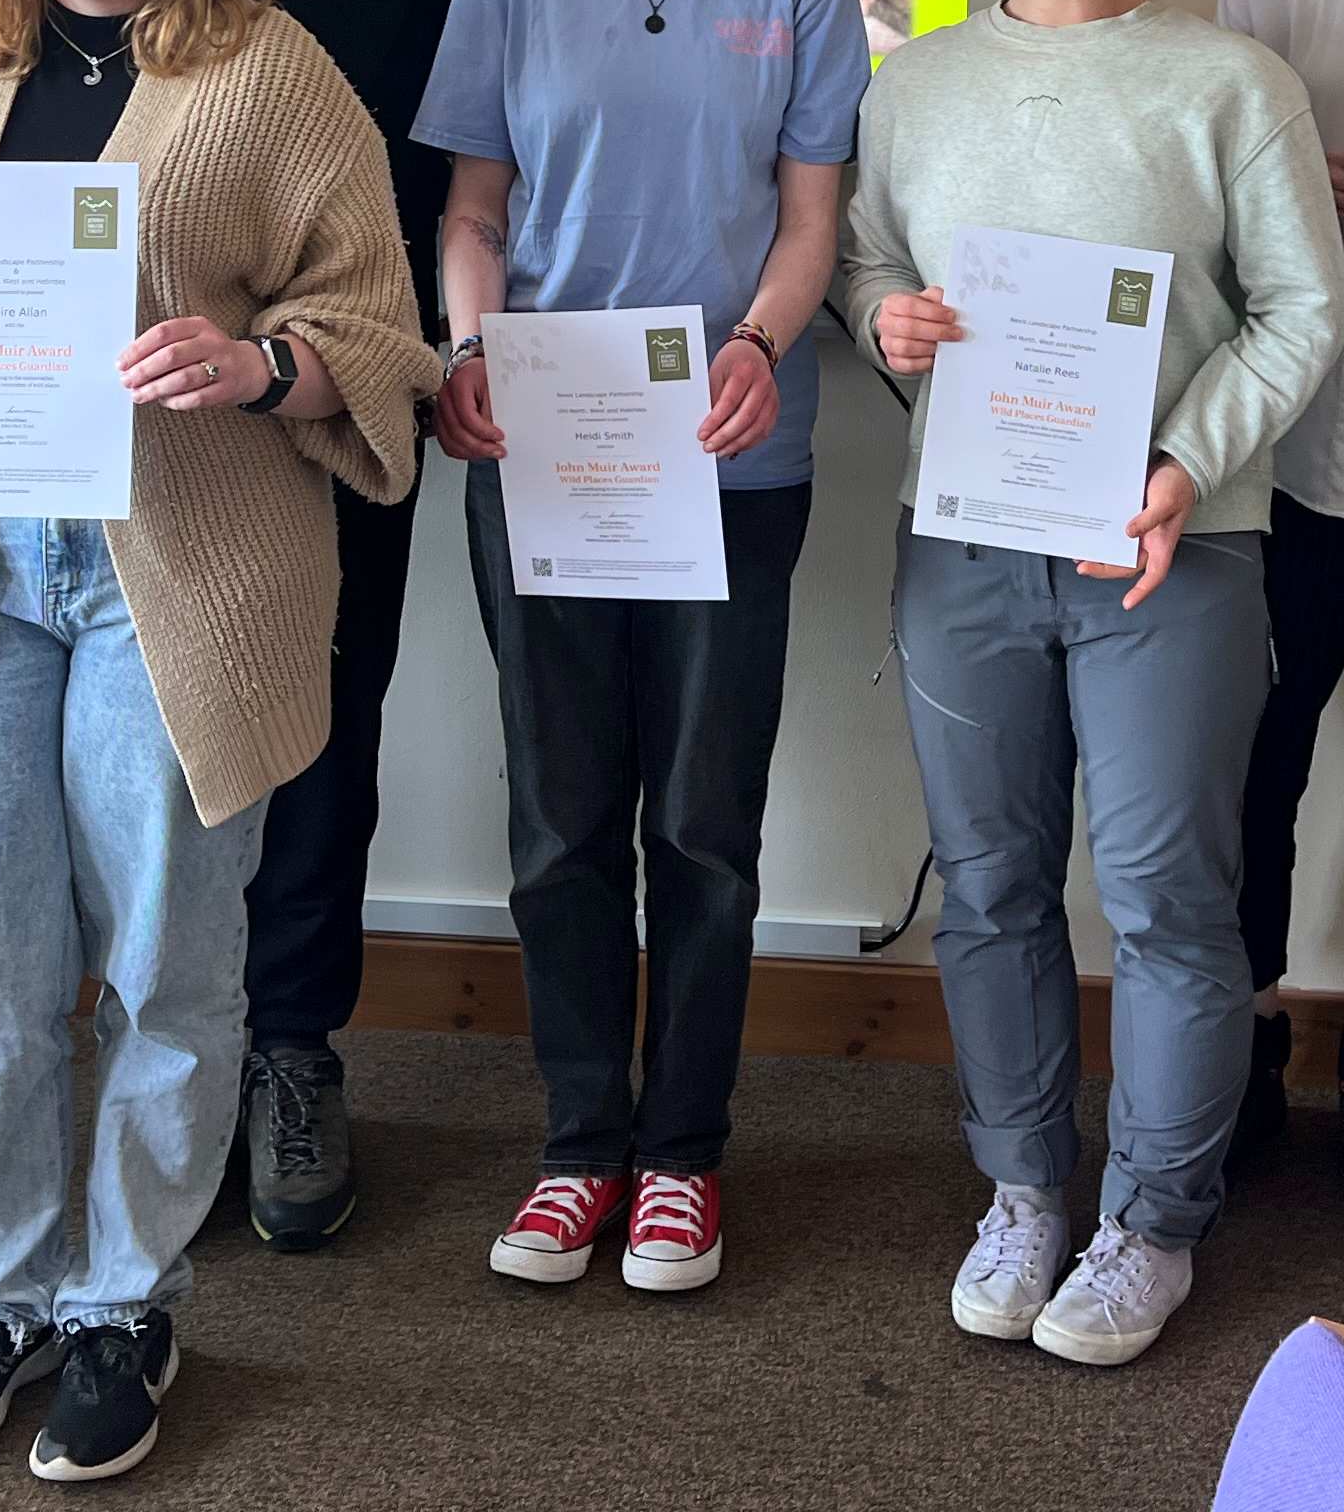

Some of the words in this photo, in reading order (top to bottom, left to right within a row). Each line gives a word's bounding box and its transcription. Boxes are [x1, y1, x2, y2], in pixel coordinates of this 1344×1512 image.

[18, 306, 47, 317] Allan
[27, 343, 71, 357] Award
[19, 361, 68, 371] Guardian
[1015, 360, 1051, 375] Natalie
[1054, 366, 1080, 379] Rees
[989, 389, 1019, 406] John
[1022, 395, 1053, 410] Muir
[1054, 399, 1096, 417] Award
[990, 405, 1012, 416] Wild
[1014, 408, 1045, 421] Places
[1046, 413, 1092, 429] Guardian
[574, 431, 601, 440] Heidi
[603, 431, 634, 440] Smith
[555, 461, 584, 472] John
[587, 461, 617, 471] Muir
[619, 461, 660, 471] Award
[582, 475, 612, 483] Places
[613, 475, 659, 483] Guardian
